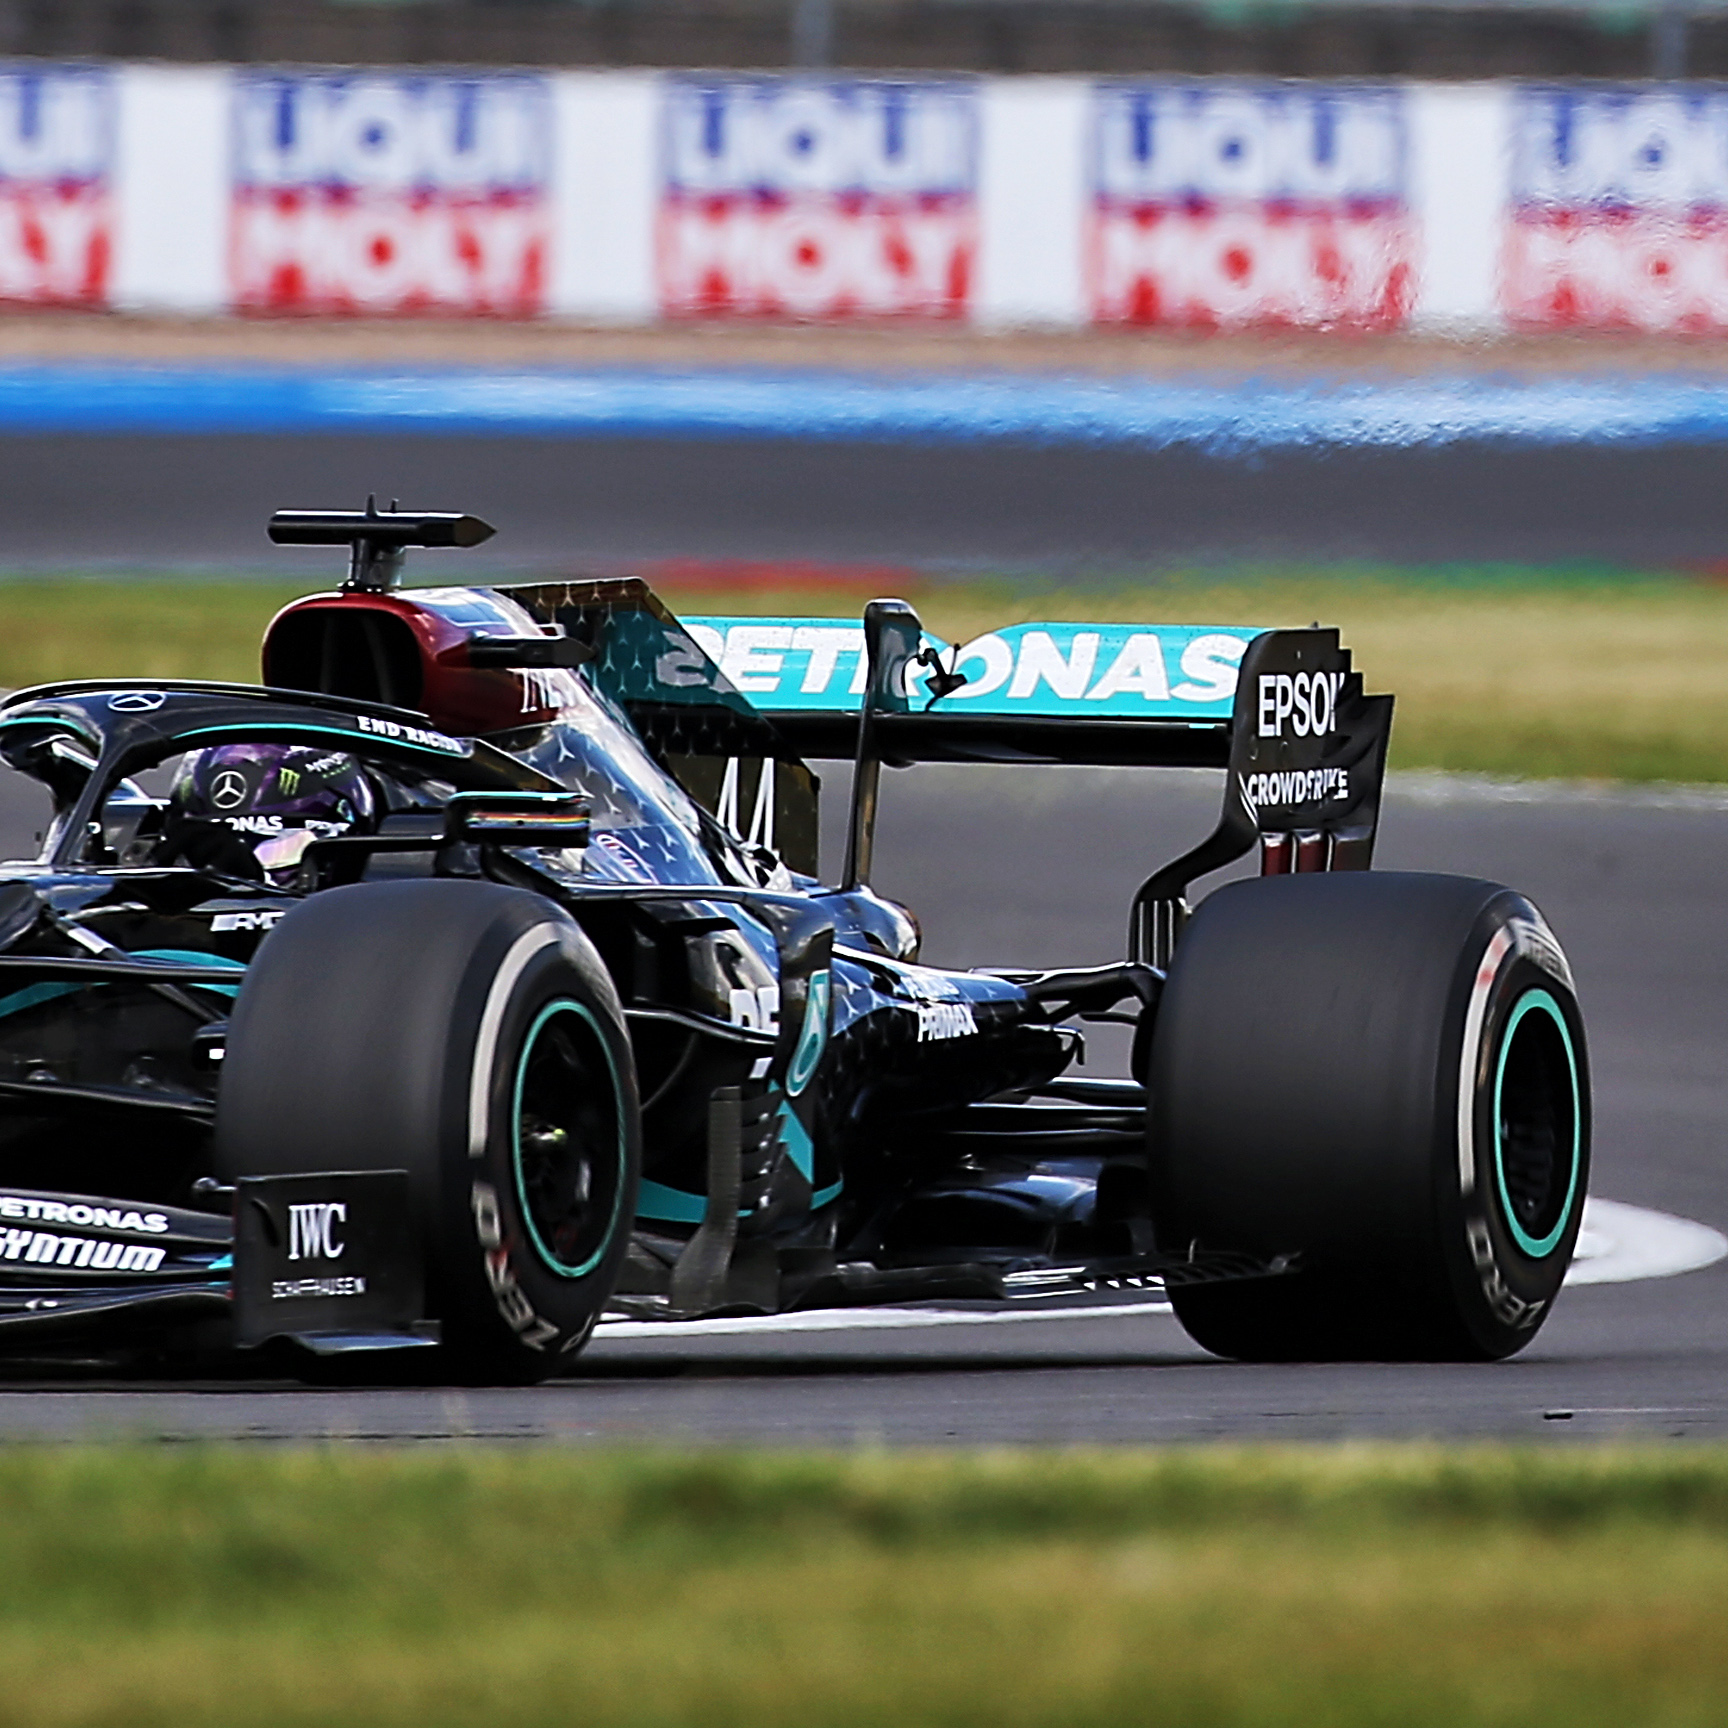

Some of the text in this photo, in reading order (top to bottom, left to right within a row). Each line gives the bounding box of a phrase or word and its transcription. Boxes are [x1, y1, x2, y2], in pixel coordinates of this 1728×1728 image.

[238, 191, 551, 304] MOLY
[668, 196, 973, 305] MOLY
[1092, 206, 1403, 315] MOLY
[356, 714, 401, 737] END
[288, 1202, 347, 1260] IWC
